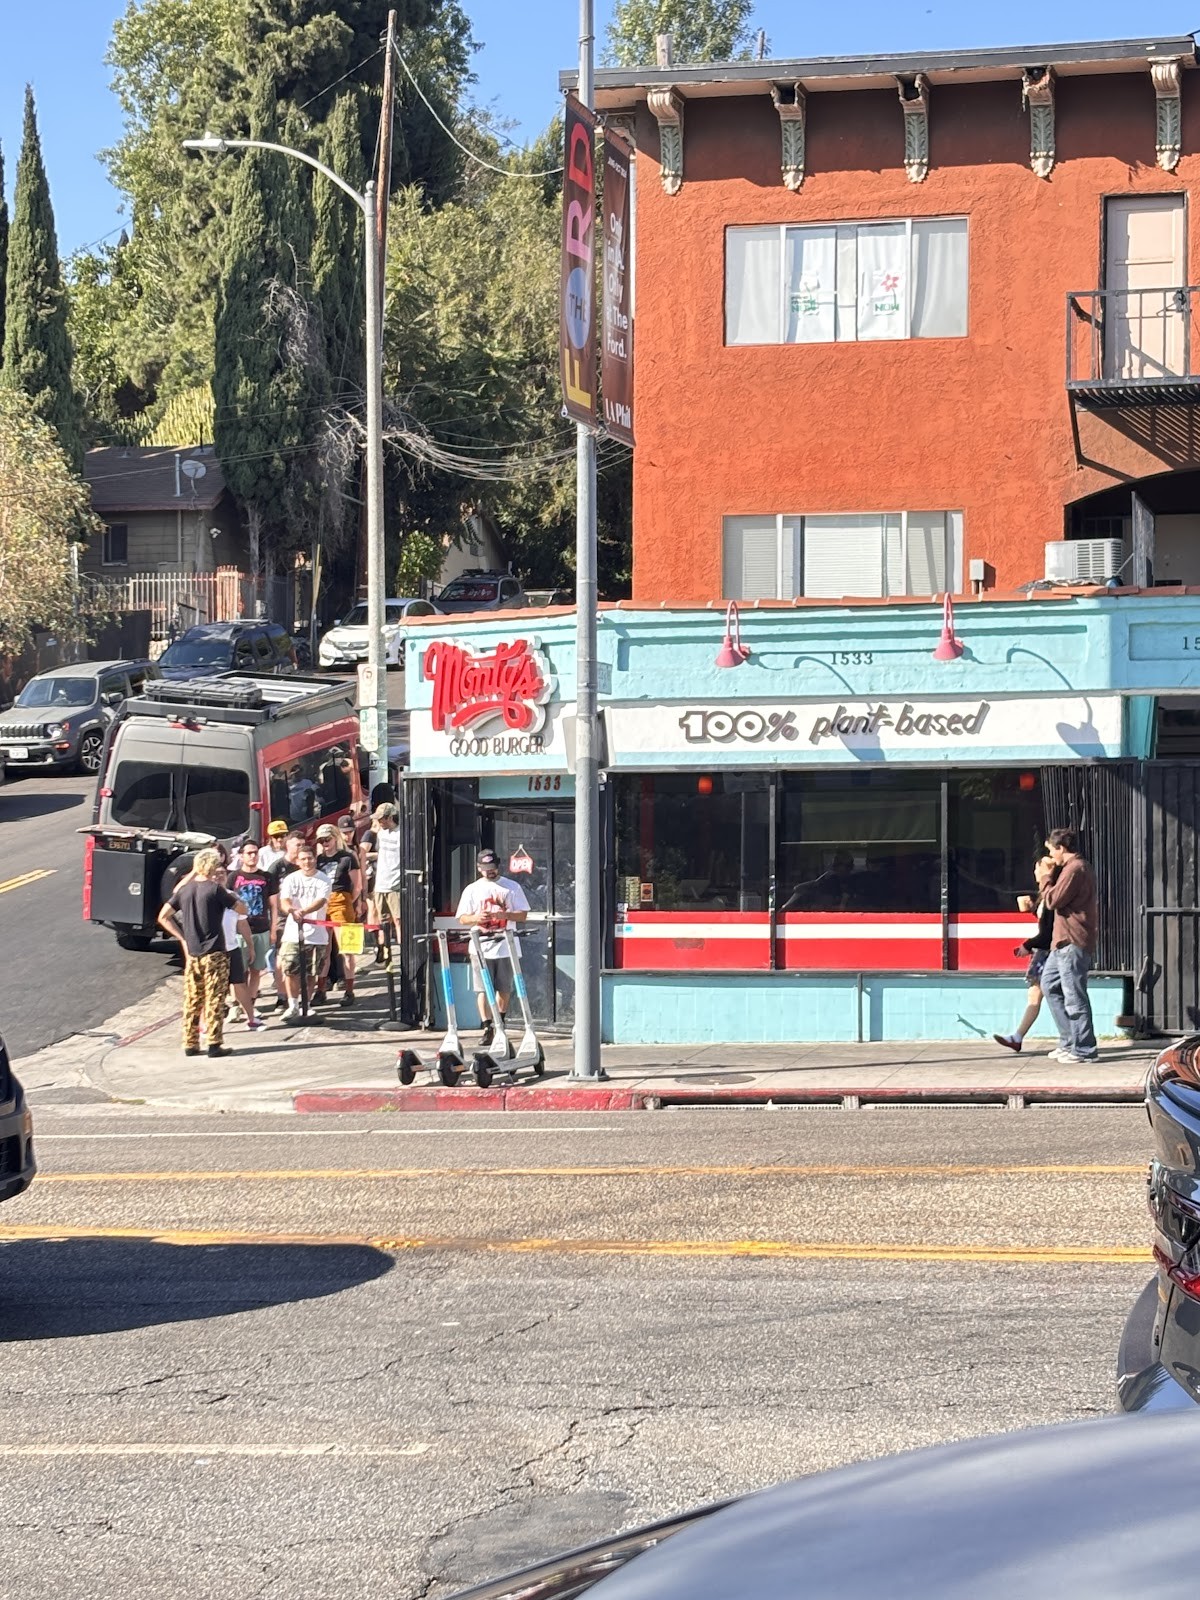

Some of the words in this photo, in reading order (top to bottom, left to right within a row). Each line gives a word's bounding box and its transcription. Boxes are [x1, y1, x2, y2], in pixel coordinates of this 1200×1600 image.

[613, 305, 628, 330] The
[831, 651, 874, 666] 1533
[423, 639, 544, 731] Monty's
[678, 710, 800, 745] 100%
[808, 700, 991, 745] plant-based
[450, 737, 490, 757] GOOD
[493, 734, 546, 756] BURGER
[528, 774, 562, 792] 1533
[511, 858, 533, 871] OPEN
